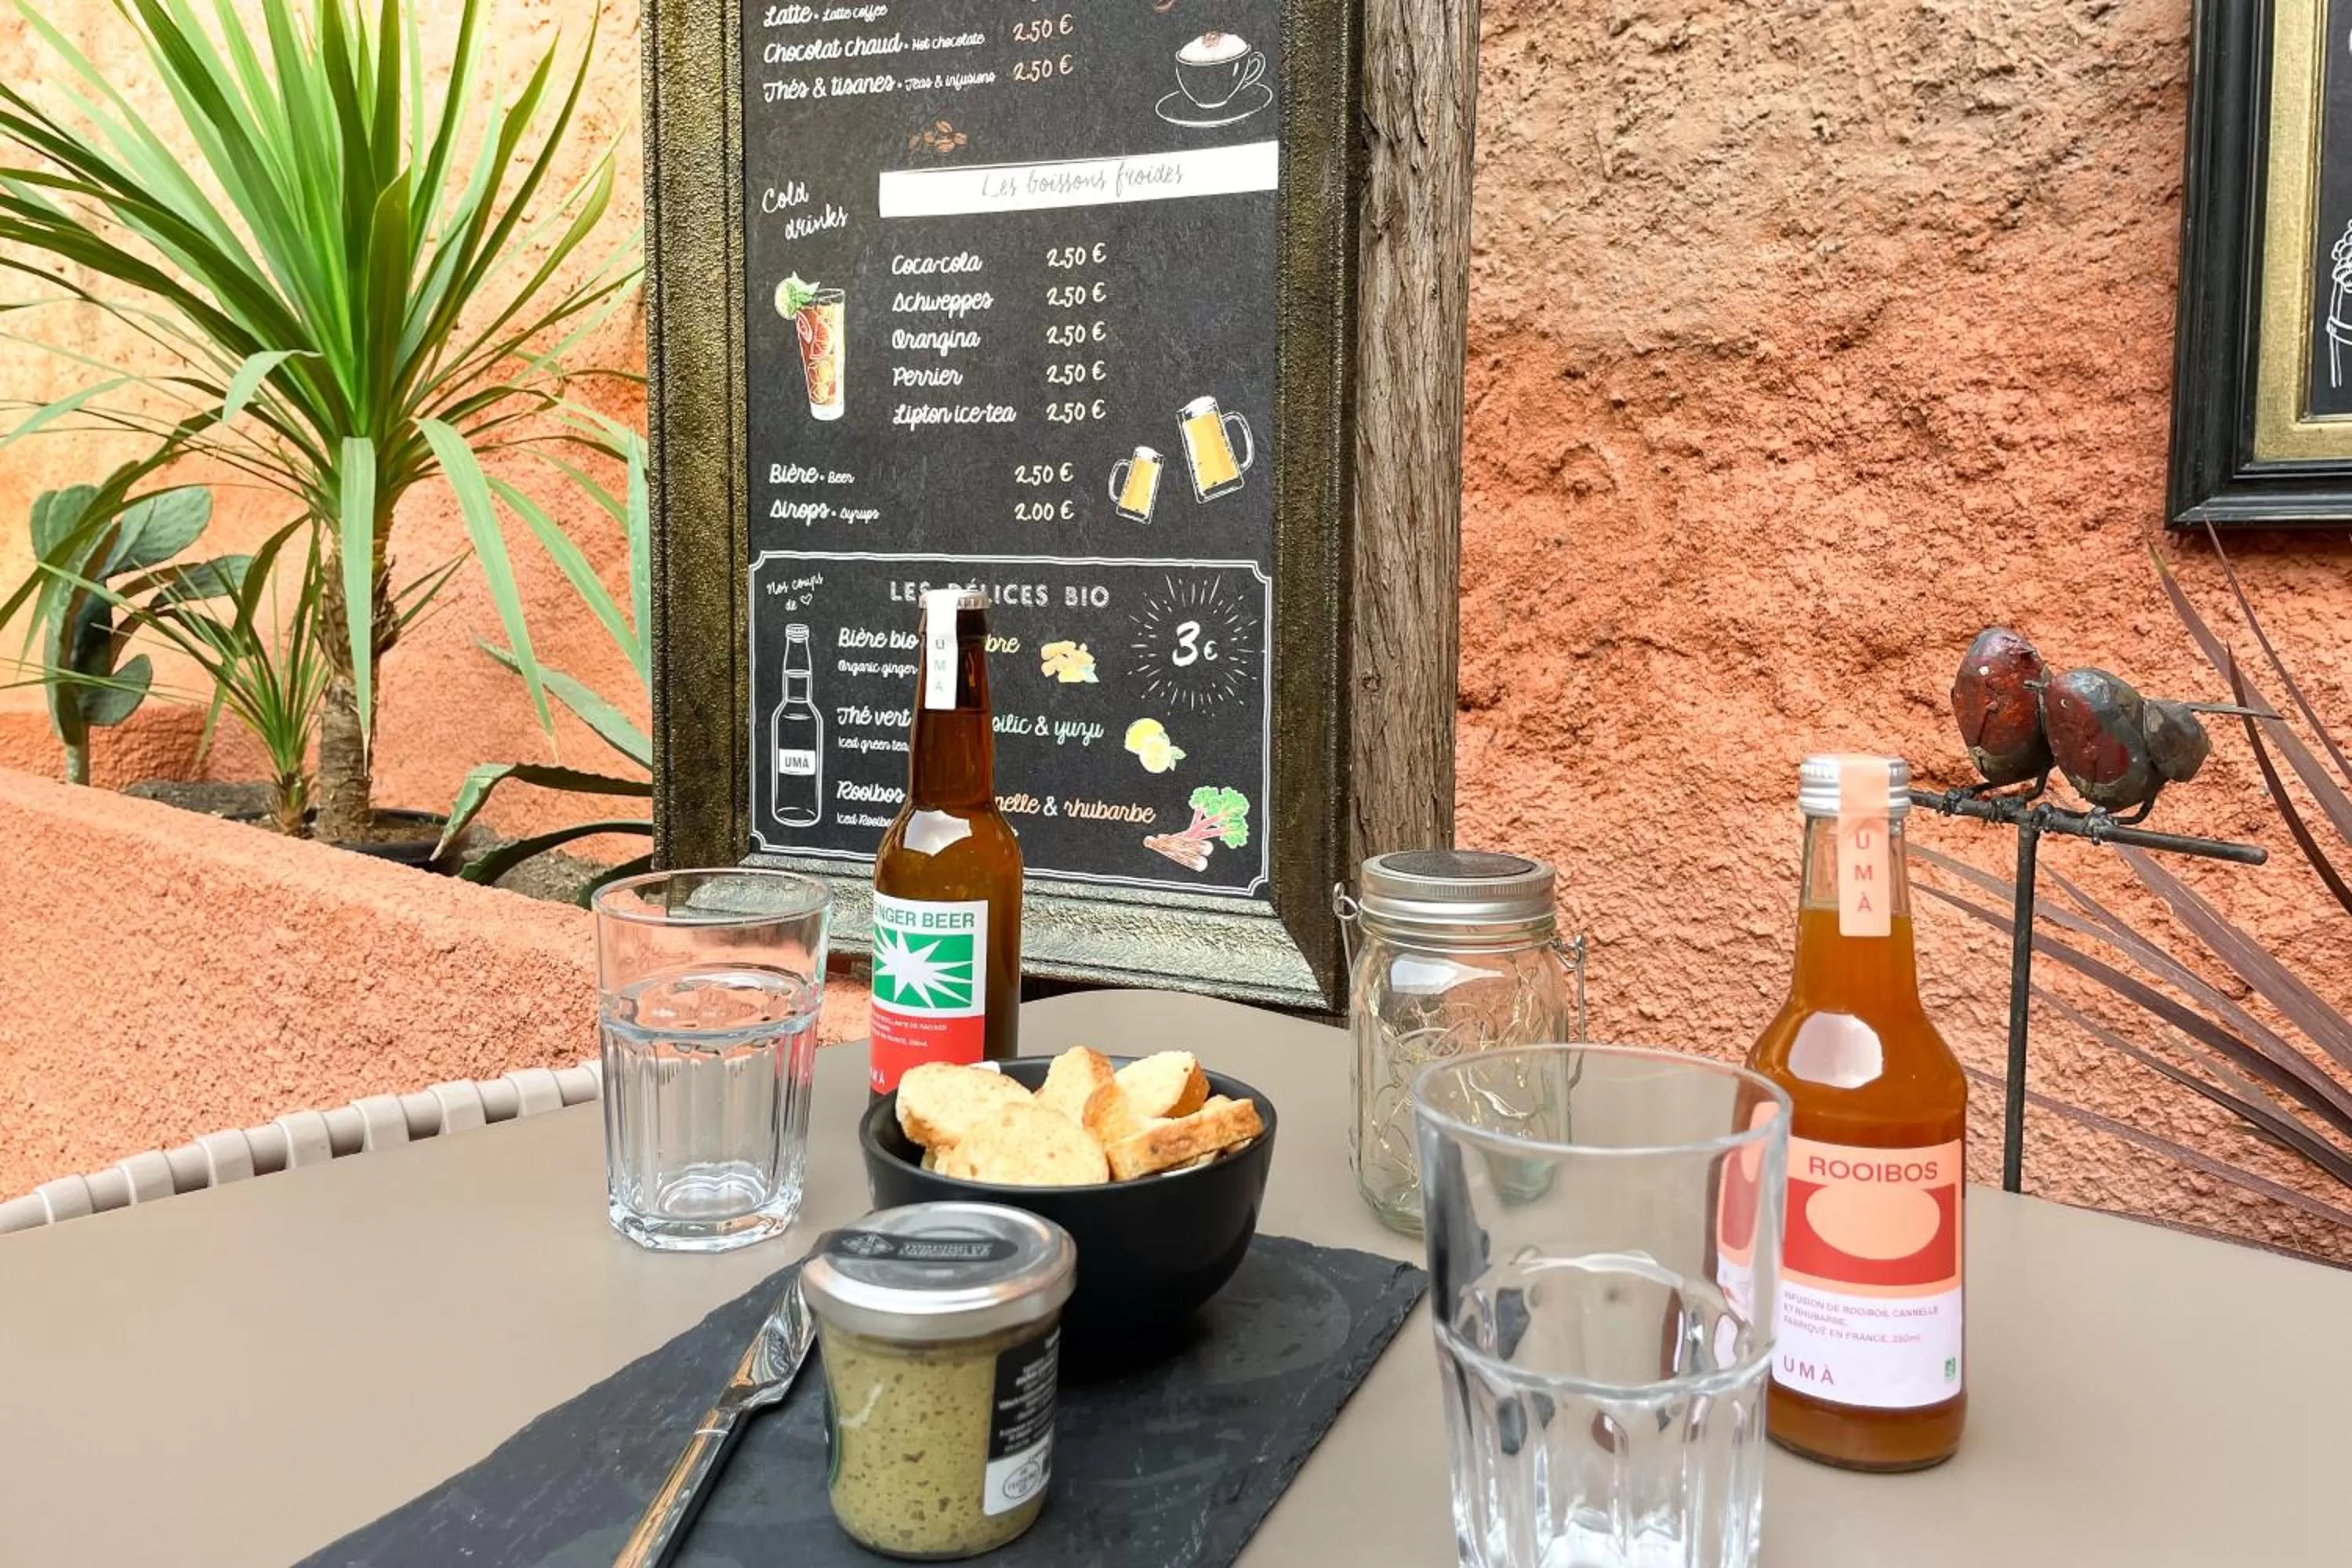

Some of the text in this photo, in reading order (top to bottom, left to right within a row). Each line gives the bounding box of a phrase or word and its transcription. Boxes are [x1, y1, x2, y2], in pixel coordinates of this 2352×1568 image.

[764, 5, 887, 27] Latte Latte coffee
[1013, 13, 1073, 42] 2.50 €
[763, 33, 985, 64] Chocolat chaud Hot chocolate
[1013, 54, 1073, 82] 2.50 €
[763, 71, 996, 103] Thés & tisanes Teas & infusions
[982, 161, 1184, 198] Les boissons froides
[761, 180, 809, 213] Cold
[785, 203, 849, 241] drinks
[1046, 241, 1107, 269] 2.50 €
[891, 291, 994, 319] Schweppes
[1046, 281, 1107, 308] 2.50 €
[891, 328, 981, 357] Orangina
[1046, 321, 1107, 347] 2.50 €
[891, 366, 964, 387] Perrier
[1046, 360, 1107, 386] 2.50 €
[892, 403, 953, 431] Lipton
[1046, 398, 1107, 424] 2.50 €
[769, 463, 855, 484] Bière Beer
[1014, 462, 1074, 485] 2.50 €
[769, 499, 831, 527] Sirops
[1014, 499, 1075, 521] 2.00 €
[766, 575, 824, 596] Nos coups
[1065, 585, 1110, 608] BIO
[785, 599, 797, 612] de
[838, 627, 919, 650] Bière bio
[837, 659, 918, 678] Organic ginger
[837, 705, 912, 727] Thé vert
[991, 713, 1105, 746] silic & yuzu
[838, 736, 909, 753] Iced green tea
[836, 781, 906, 804] Rooibos
[837, 812, 895, 828] Iced Rooibo
[994, 793, 1156, 823] nelle & rhubarbe
[876, 903, 975, 929] NGER BEER
[1809, 1156, 1939, 1183] ROOIBOS
